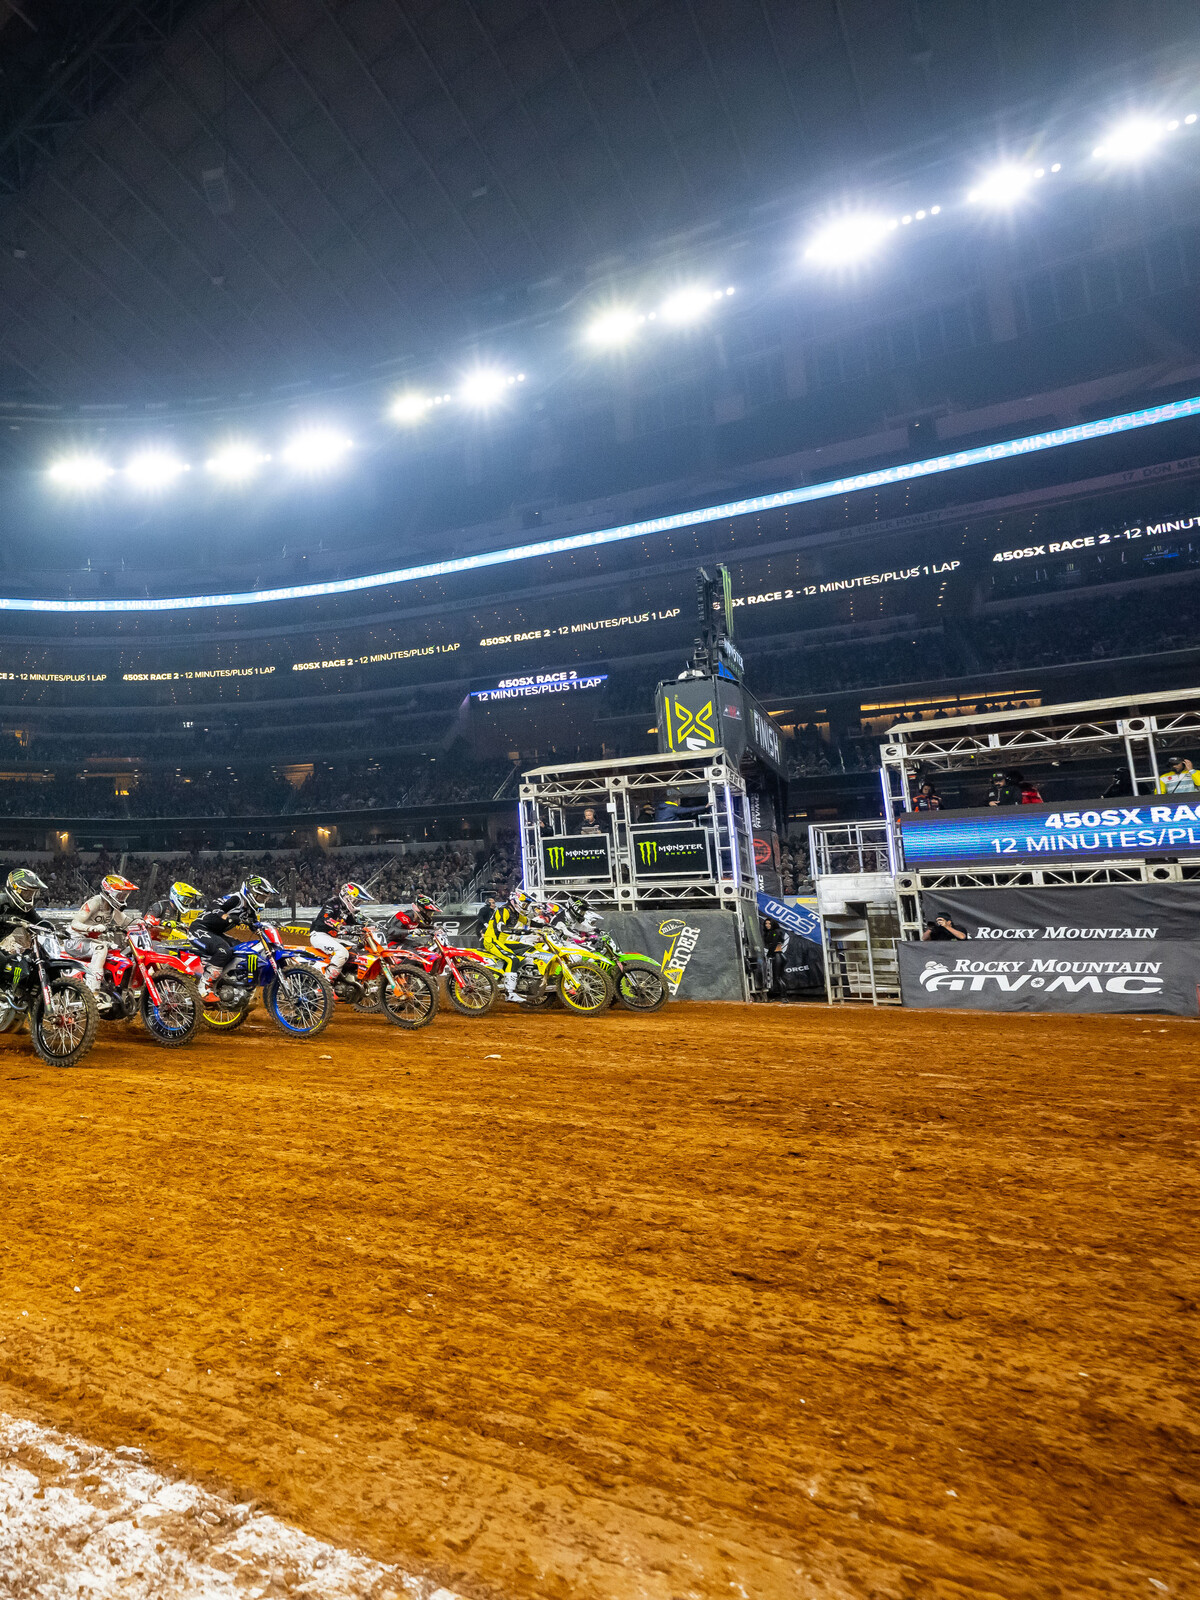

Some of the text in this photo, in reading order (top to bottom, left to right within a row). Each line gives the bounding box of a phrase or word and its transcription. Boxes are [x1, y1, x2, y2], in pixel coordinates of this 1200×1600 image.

[993, 544, 1046, 563] 450SX
[1049, 536, 1095, 553] RACE
[1099, 533, 1111, 544] 2
[1124, 528, 1141, 539] 12
[747, 591, 782, 605] RACE
[785, 590, 794, 599] 2
[803, 586, 817, 596] 12
[820, 565, 920, 593] MINUTES/PLUS
[932, 560, 960, 573] LAP
[480, 635, 511, 647] 450SX
[514, 630, 541, 642] RACE
[543, 629, 550, 637] 2
[558, 626, 568, 635] 12
[571, 613, 649, 633] MINUTES/PLUS
[659, 608, 680, 619] LAP
[292, 662, 320, 672] 450SX
[322, 659, 346, 670] RACE
[347, 658, 353, 667] 2
[359, 656, 368, 665] 12
[442, 643, 460, 652] LAP
[478, 693, 488, 701] 12
[490, 683, 571, 700] MINUTES/PLUS
[580, 678, 601, 688] LAP
[498, 671, 577, 689] 450SX RACE 2
[1045, 808, 1144, 829] 450SX
[566, 849, 606, 857] MONSTER
[658, 843, 703, 852] MONSTER
[991, 838, 1018, 853] 12
[765, 901, 816, 935] WPS
[975, 926, 1160, 940] ROCKY MOUNTAIN
[785, 965, 810, 974] ORCE
[953, 959, 1162, 974] ROCKY MOUNTAIN
